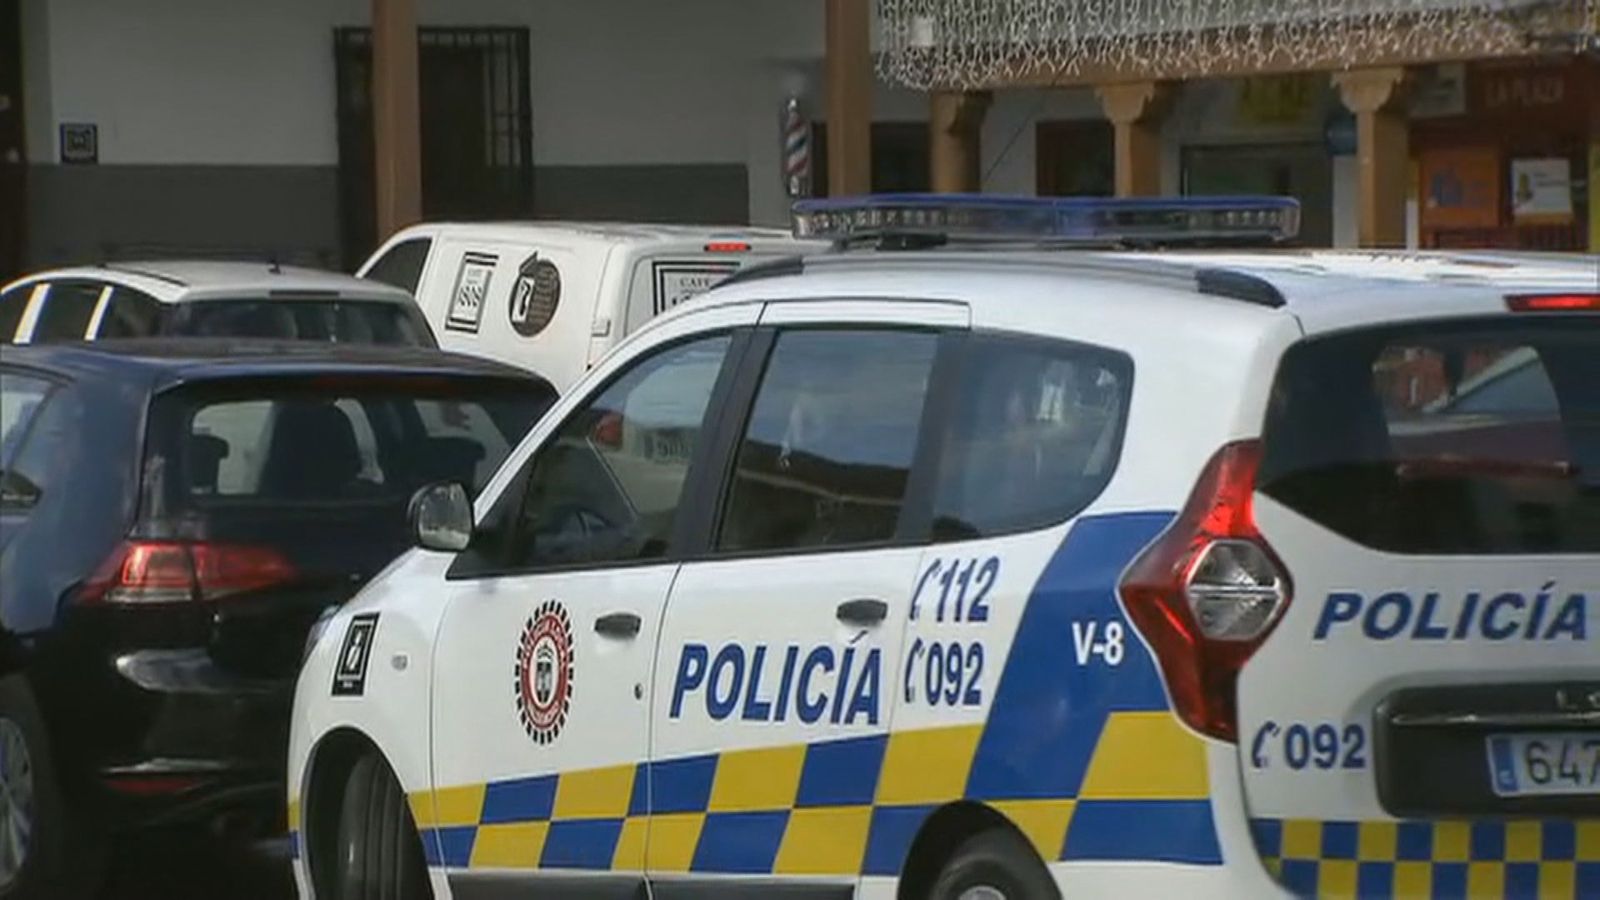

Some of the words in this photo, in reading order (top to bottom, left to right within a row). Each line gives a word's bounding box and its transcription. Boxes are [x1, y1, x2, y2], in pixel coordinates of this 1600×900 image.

[935, 556, 1001, 622] 112
[1313, 581, 1588, 641] POLICÍA
[925, 642, 985, 707] 092
[1072, 621, 1124, 666] V-8
[669, 630, 882, 726] POLICÍA
[1284, 723, 1367, 770] 092
